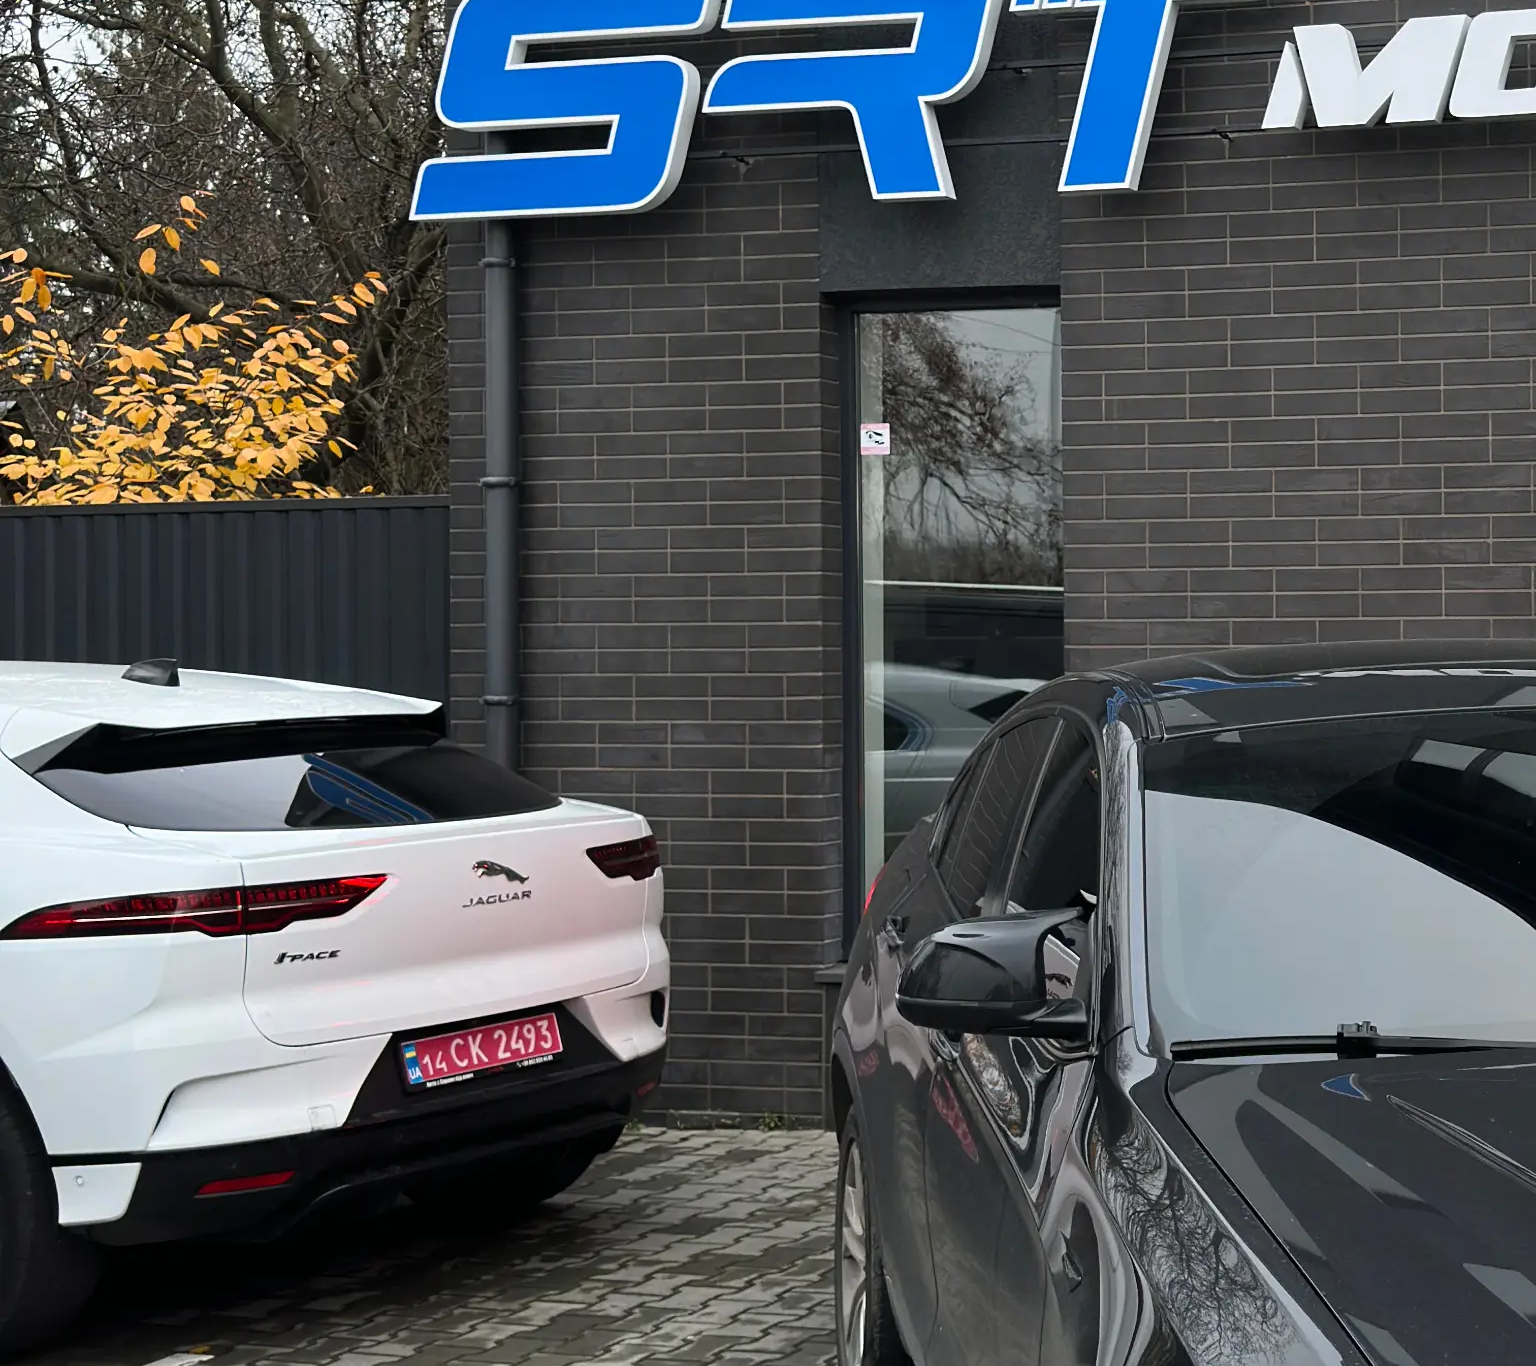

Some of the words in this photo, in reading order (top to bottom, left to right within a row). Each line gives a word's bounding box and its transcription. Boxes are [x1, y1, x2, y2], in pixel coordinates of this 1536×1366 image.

[462, 890, 532, 908] JAGUAR
[422, 1051, 448, 1076] 14
[493, 1019, 553, 1060] 2493
[408, 1065, 423, 1080] UA
